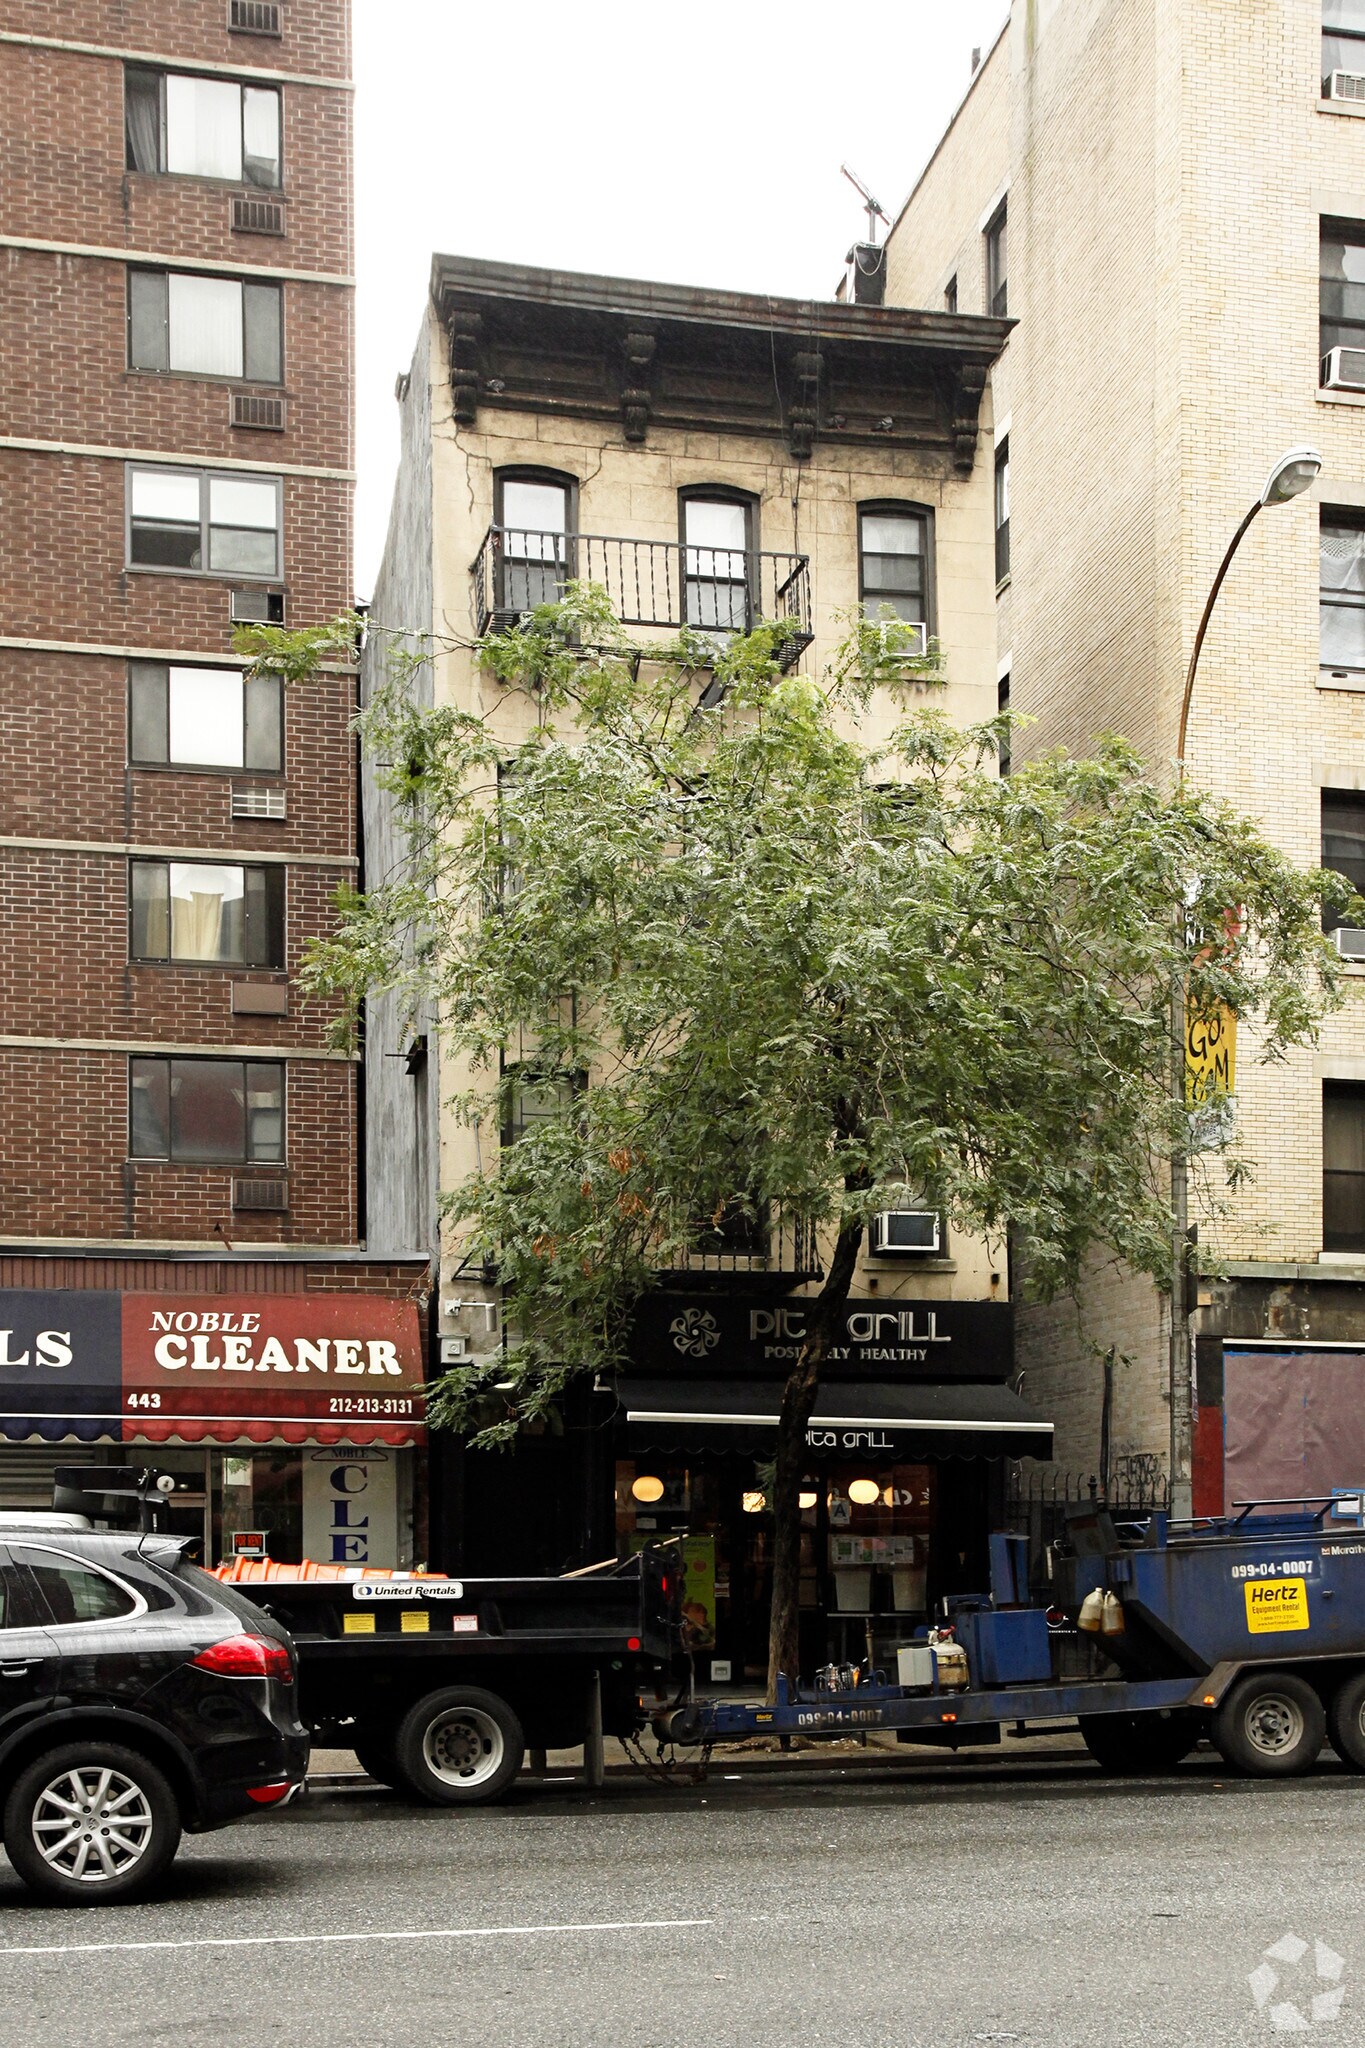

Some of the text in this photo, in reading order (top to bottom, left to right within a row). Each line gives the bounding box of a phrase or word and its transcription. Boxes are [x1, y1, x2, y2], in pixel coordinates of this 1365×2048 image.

[149, 1311, 261, 1333] NOBLE
[154, 1334, 403, 1376] CLEANER
[860, 1348, 928, 1361] HEALTHY
[127, 1393, 161, 1409] 443
[329, 1398, 413, 1414] 212-213-3131
[331, 1448, 369, 1459] NOBLE
[834, 1503, 846, 1517] A
[235, 1535, 262, 1547] FOR RENT
[1231, 1560, 1313, 1578] 099-04-0007
[375, 1586, 456, 1596] United Rentals
[1252, 1586, 1298, 1602] Hertz
[1252, 1603, 1299, 1614] Equipment Rental
